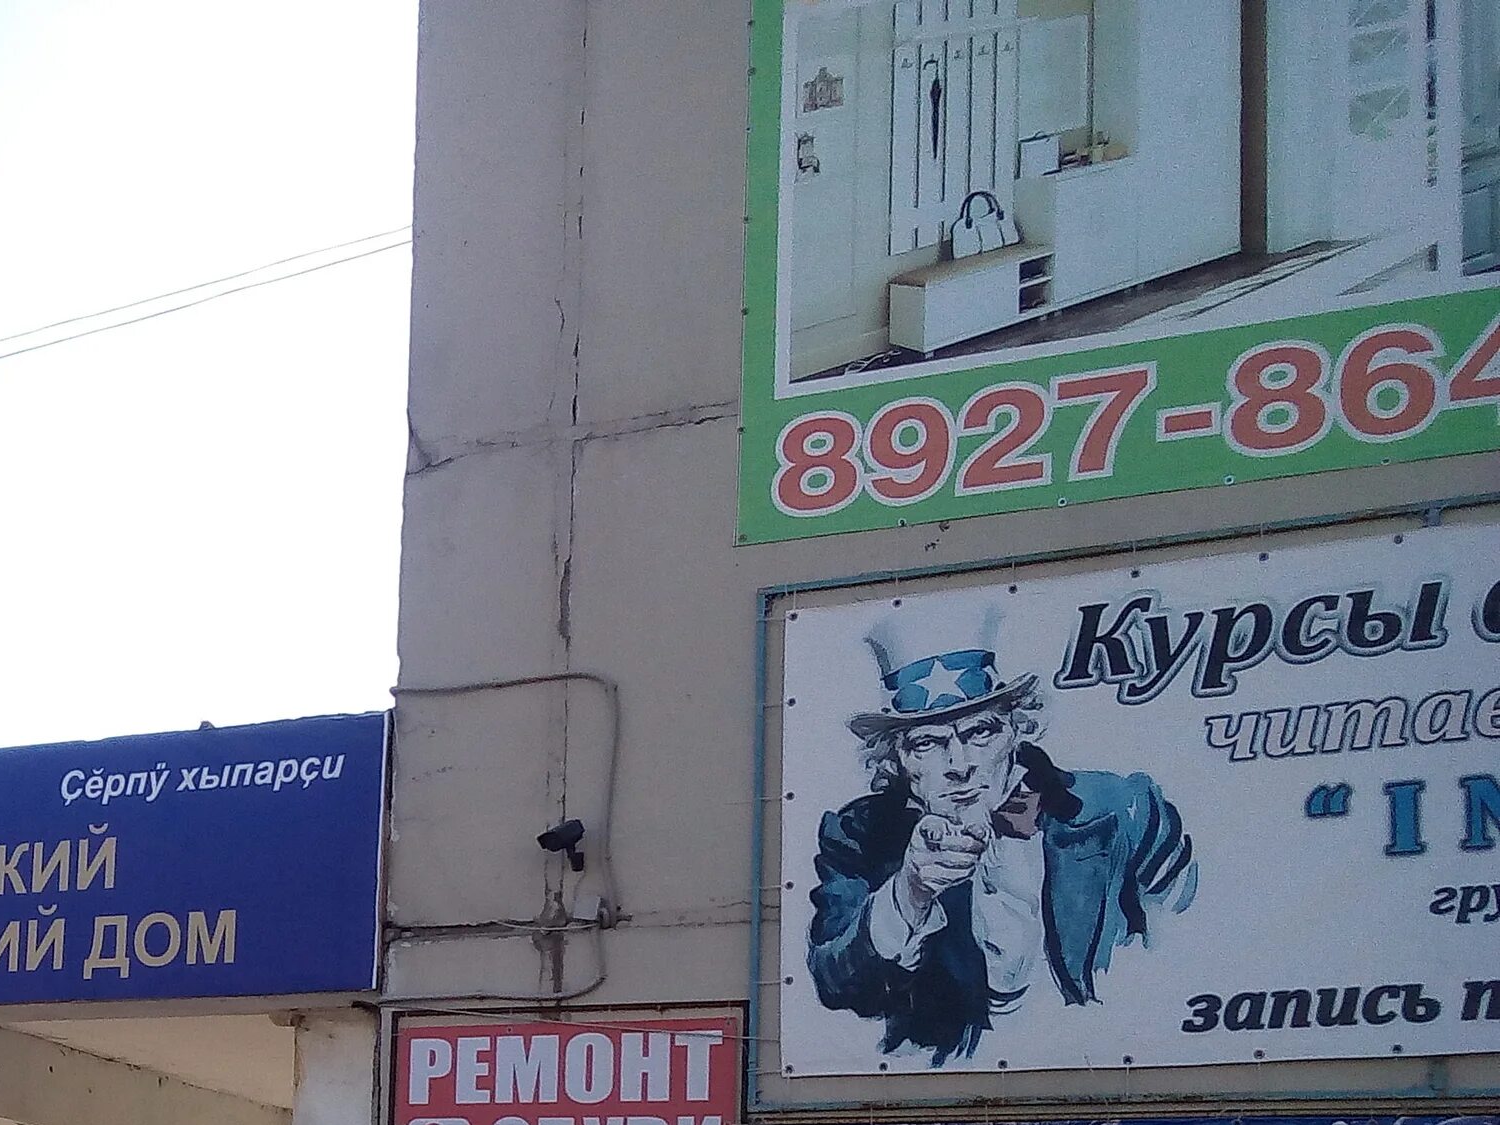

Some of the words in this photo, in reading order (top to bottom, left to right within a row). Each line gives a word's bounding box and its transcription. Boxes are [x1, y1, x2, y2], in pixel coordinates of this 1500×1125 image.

[1058, 580, 1446, 702] Курсы
[83, 908, 239, 981] ДОМ
[1182, 982, 1442, 1034] запись
[407, 1030, 724, 1105] РЕМОНТ
